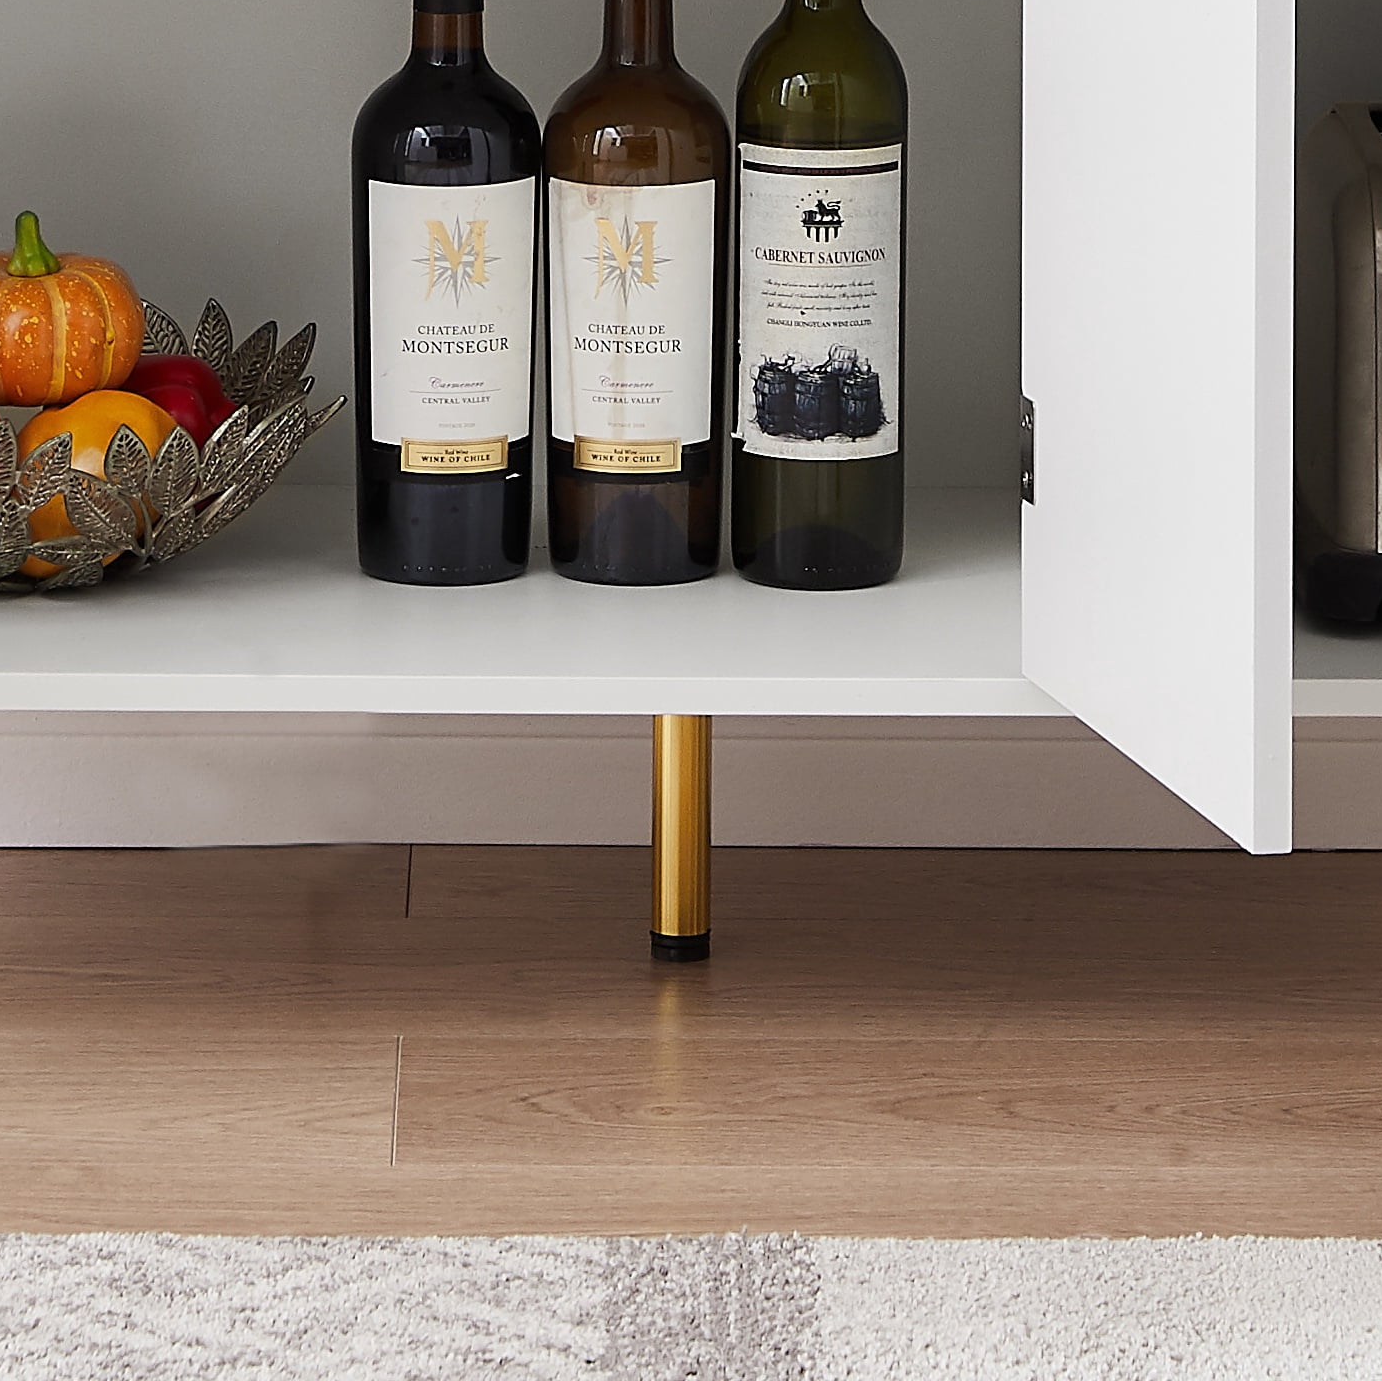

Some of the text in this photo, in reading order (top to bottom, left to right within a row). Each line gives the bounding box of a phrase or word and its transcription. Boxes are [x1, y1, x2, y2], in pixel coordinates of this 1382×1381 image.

[755, 246, 886, 265] CABERNET SAUVIGNON
[417, 323, 495, 336] CHATEAU DE
[588, 323, 666, 336] CHATEAU DE
[402, 337, 509, 354] MONTSEGUR
[574, 337, 682, 354] MONTSEGUR
[422, 396, 491, 405] CENTRAL VALLEY
[592, 396, 661, 405] CENTRAL VALLEY
[421, 455, 444, 463] WINE
[464, 454, 490, 463] CHILE
[591, 454, 661, 463] WINE OF CHILE
